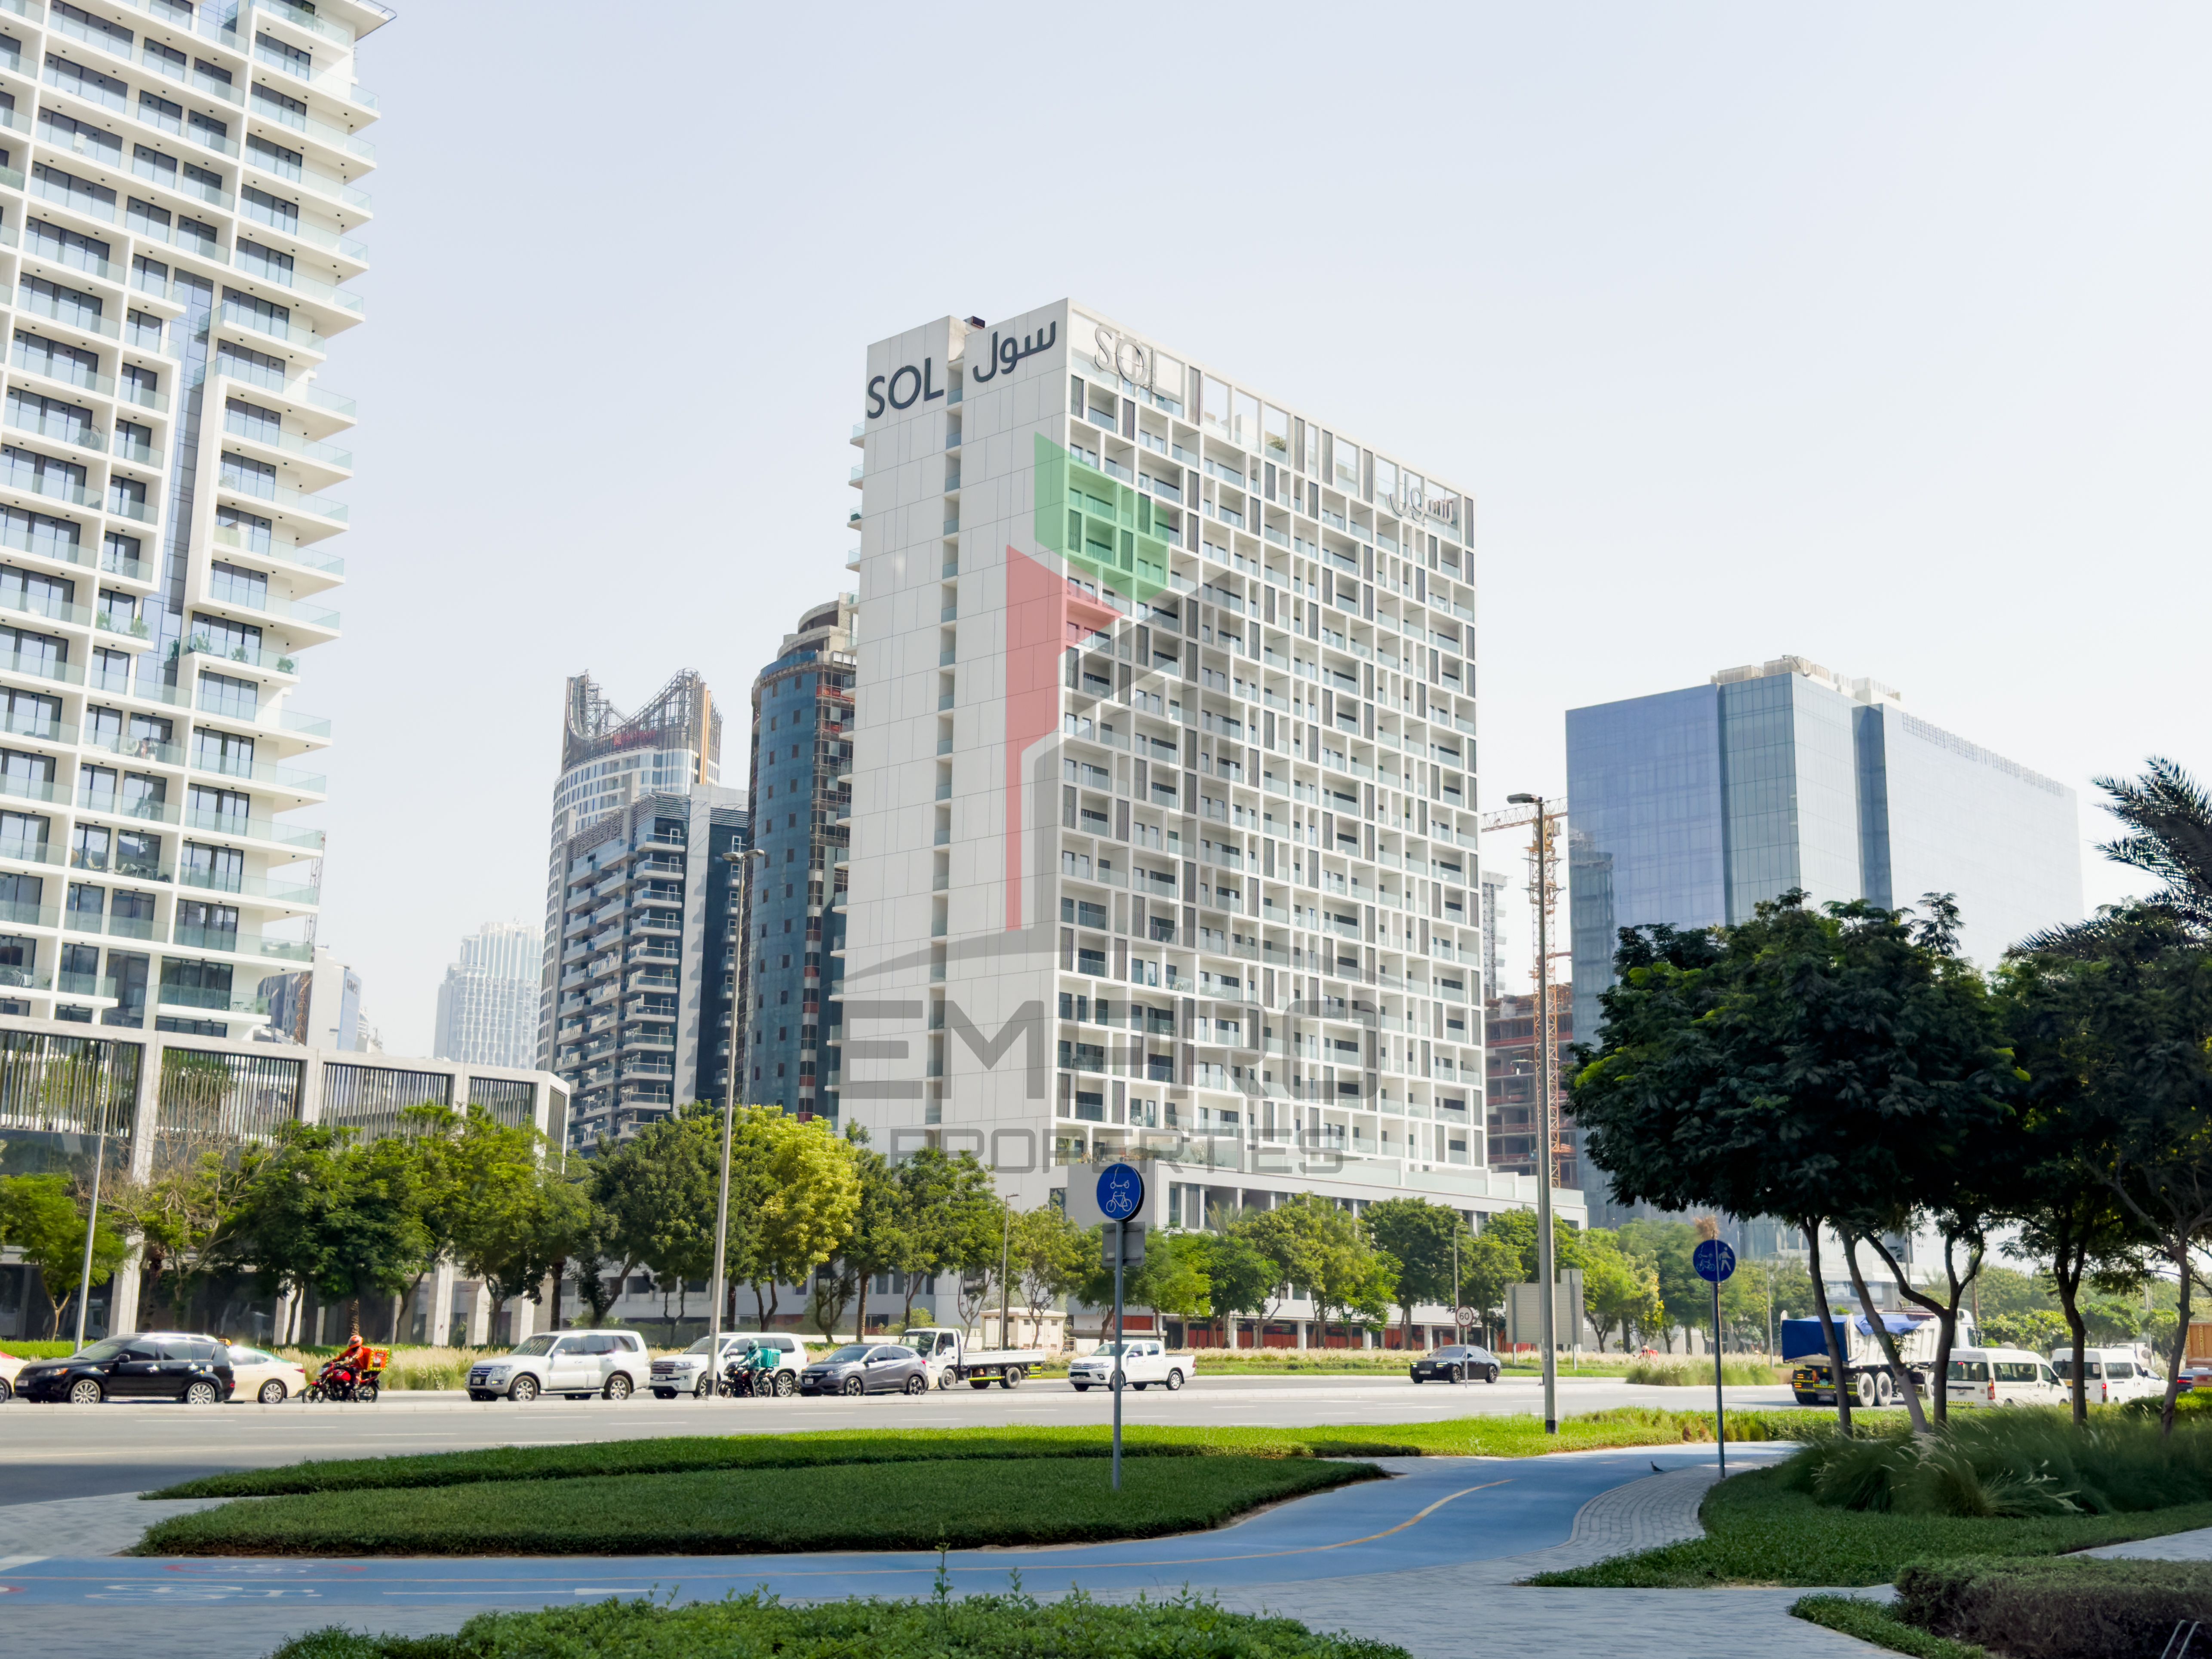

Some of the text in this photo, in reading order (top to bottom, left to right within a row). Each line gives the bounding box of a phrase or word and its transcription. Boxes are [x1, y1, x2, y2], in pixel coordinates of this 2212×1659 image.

[972, 320, 1056, 383] سول
[1095, 325, 1169, 400] SOL
[867, 357, 944, 419] SOL
